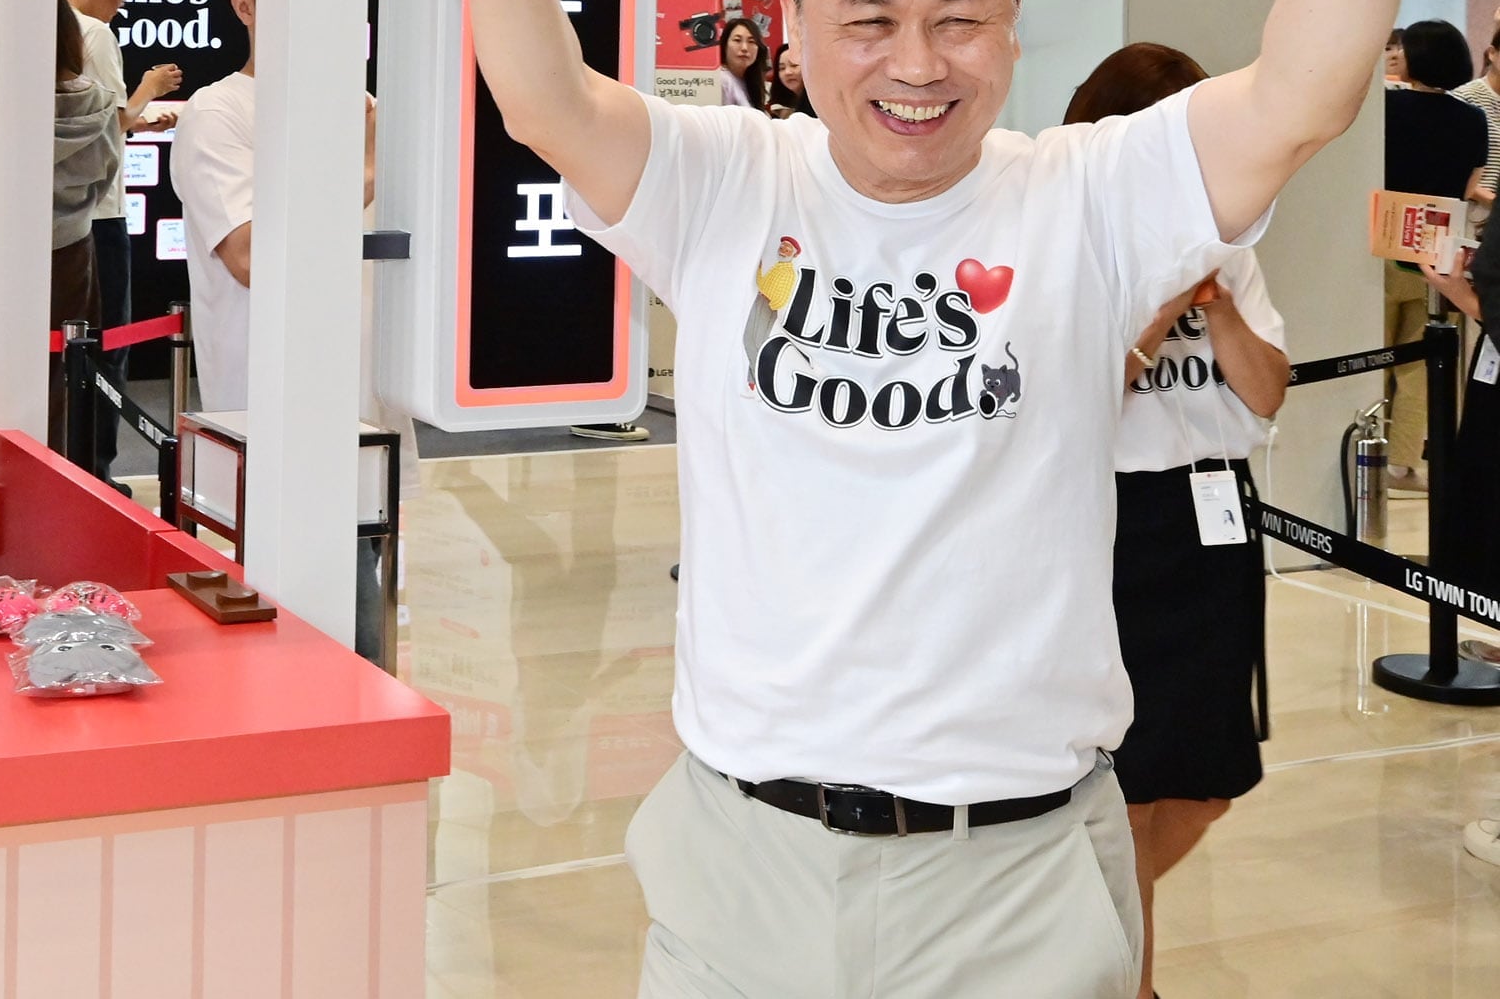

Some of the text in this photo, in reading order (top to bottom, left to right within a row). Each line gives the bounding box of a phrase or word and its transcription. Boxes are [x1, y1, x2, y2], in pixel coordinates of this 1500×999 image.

[782, 267, 981, 357] Life's
[1337, 361, 1347, 373] LG
[1261, 511, 1332, 554] WIN TOWERS
[1405, 567, 1423, 592] LG
[1425, 575, 1465, 609] TWIN
